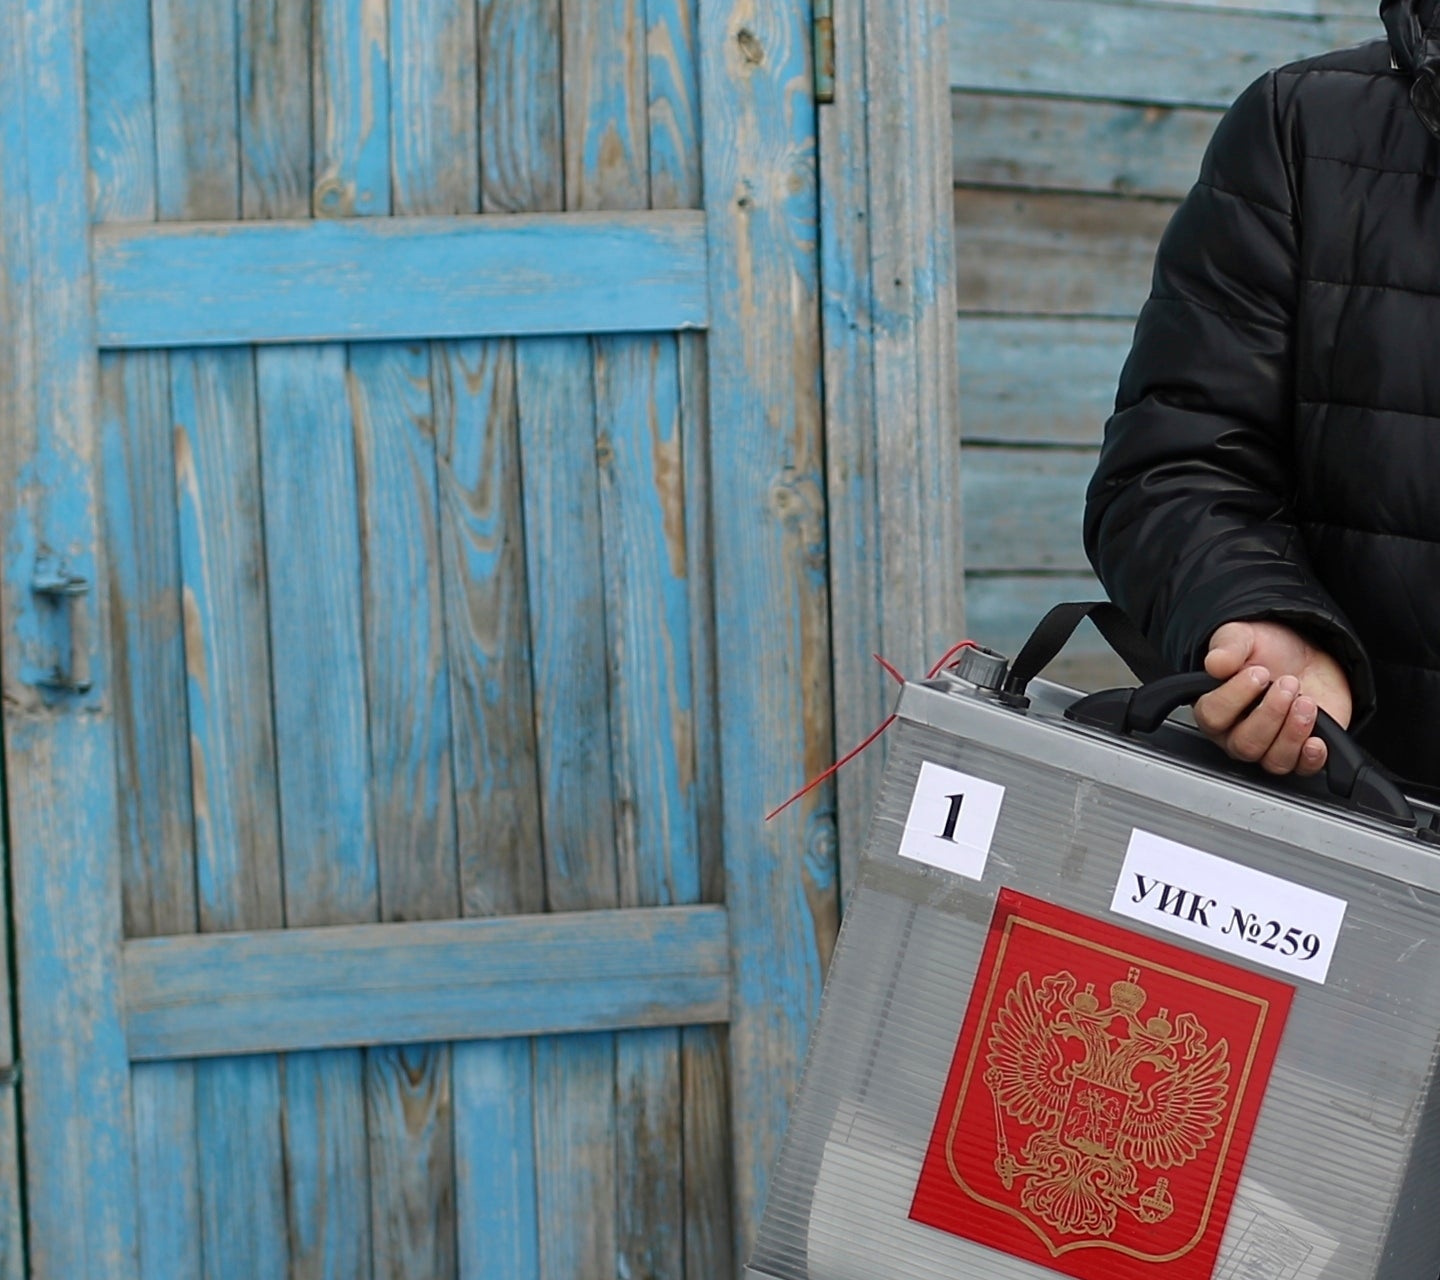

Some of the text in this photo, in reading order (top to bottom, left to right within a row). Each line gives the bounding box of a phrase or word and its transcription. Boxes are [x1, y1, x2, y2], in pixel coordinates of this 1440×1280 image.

[933, 793, 964, 844] 1
[1131, 872, 1321, 961] УИК №259
